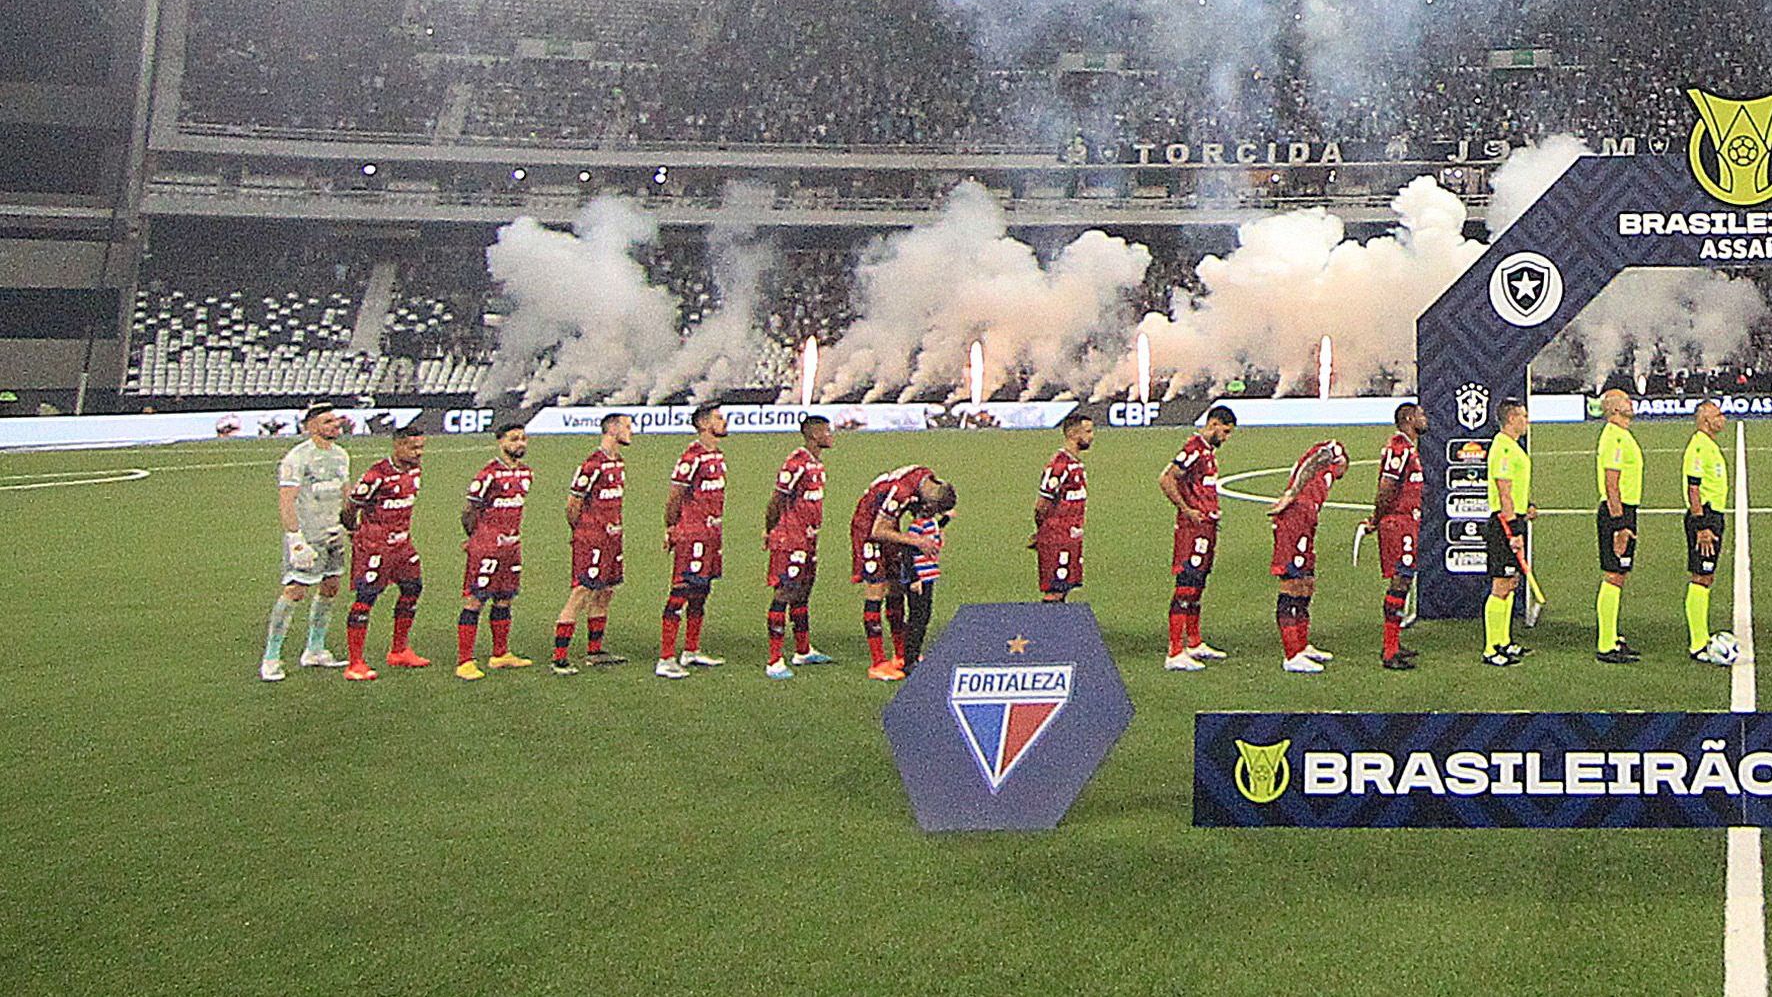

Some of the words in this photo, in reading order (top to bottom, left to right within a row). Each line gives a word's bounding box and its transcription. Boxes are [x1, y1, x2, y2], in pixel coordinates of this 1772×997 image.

[1134, 142, 1343, 164] TORCIDA
[444, 409, 494, 433] CBF
[1109, 402, 1160, 427] CBF
[957, 672, 1067, 693] FORTALEZA
